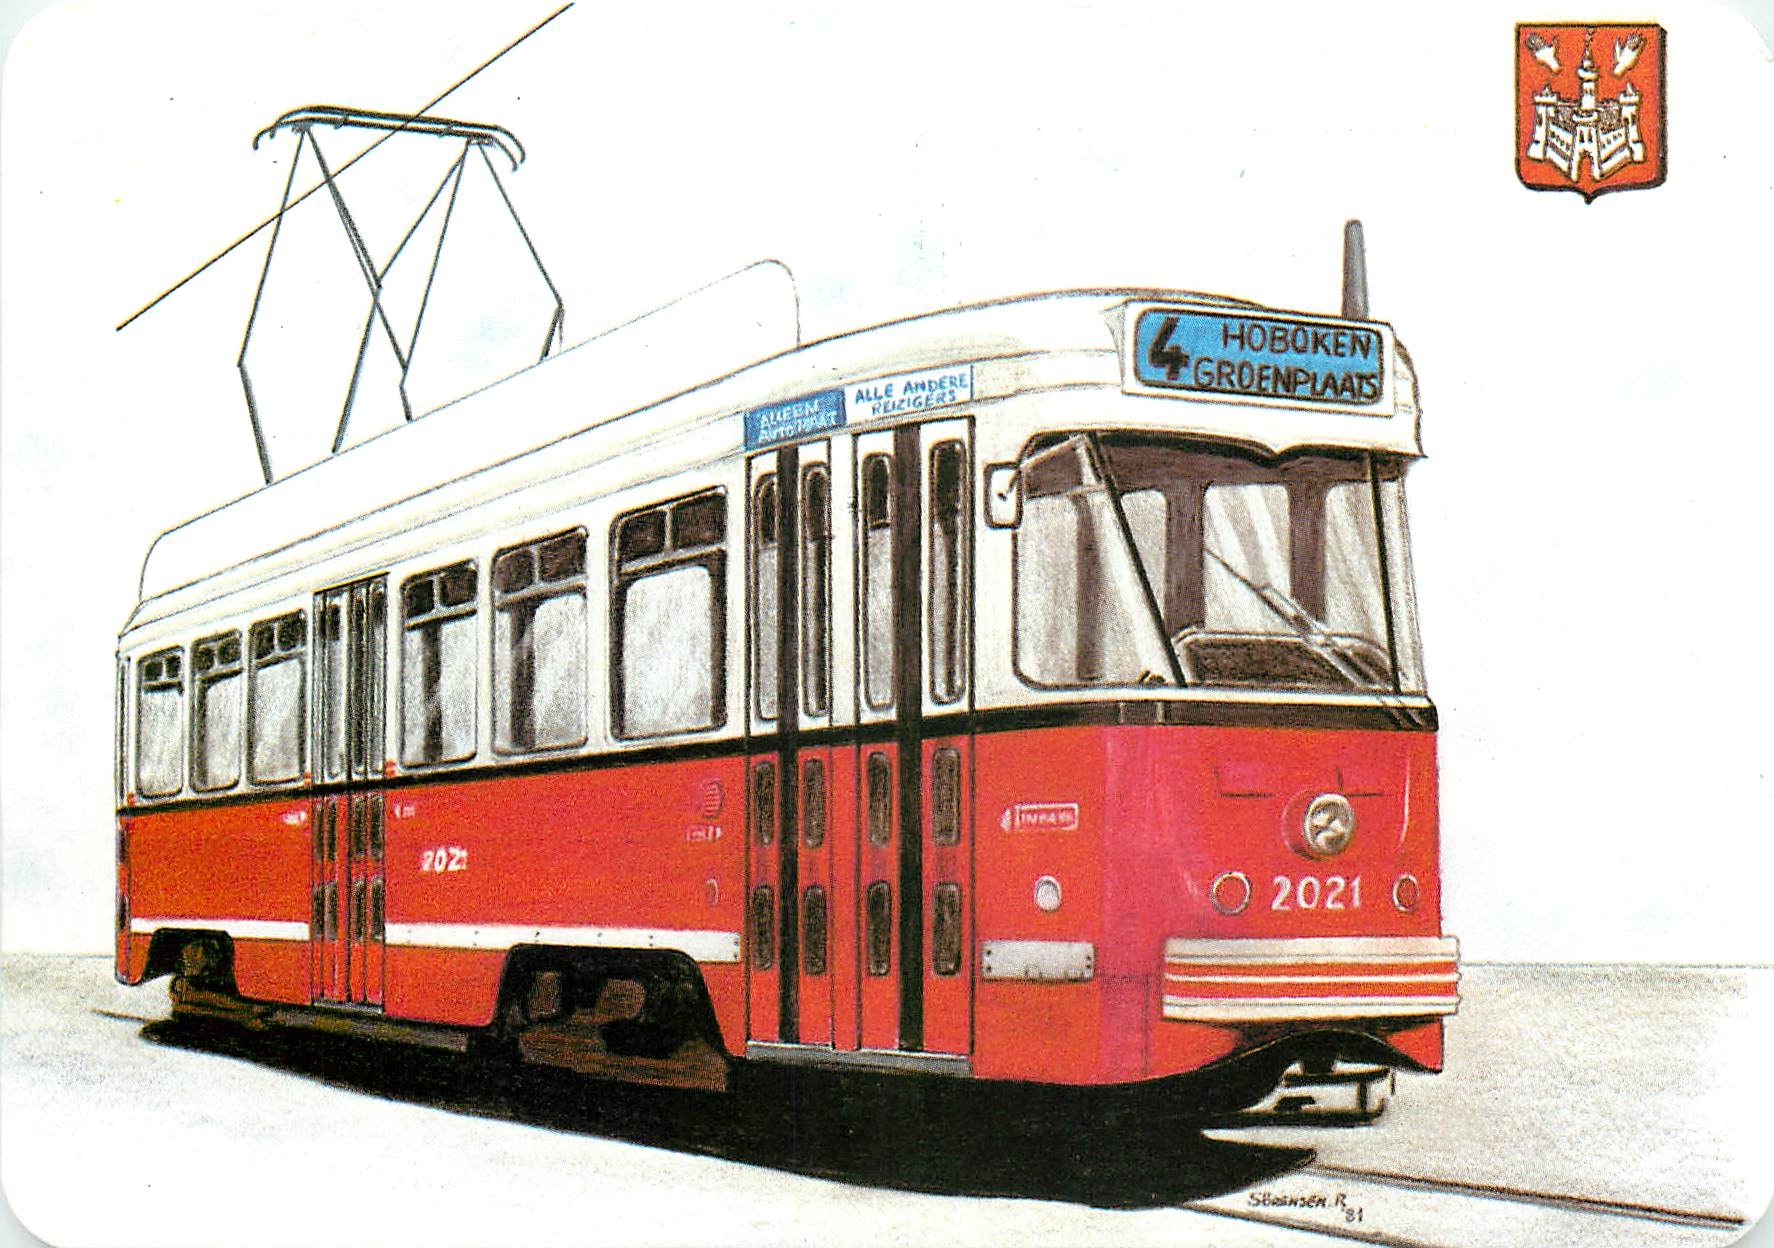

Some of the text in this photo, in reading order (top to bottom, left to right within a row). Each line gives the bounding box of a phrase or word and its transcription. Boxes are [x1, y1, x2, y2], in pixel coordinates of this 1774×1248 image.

[1148, 316, 1190, 381] 4
[1221, 322, 1372, 360] HOBOKEN
[855, 373, 968, 405] ALLE ANDERE
[1193, 356, 1380, 400] GROENPLAATS
[872, 388, 957, 416] REIZIGERS
[1271, 875, 1361, 911] 2021
